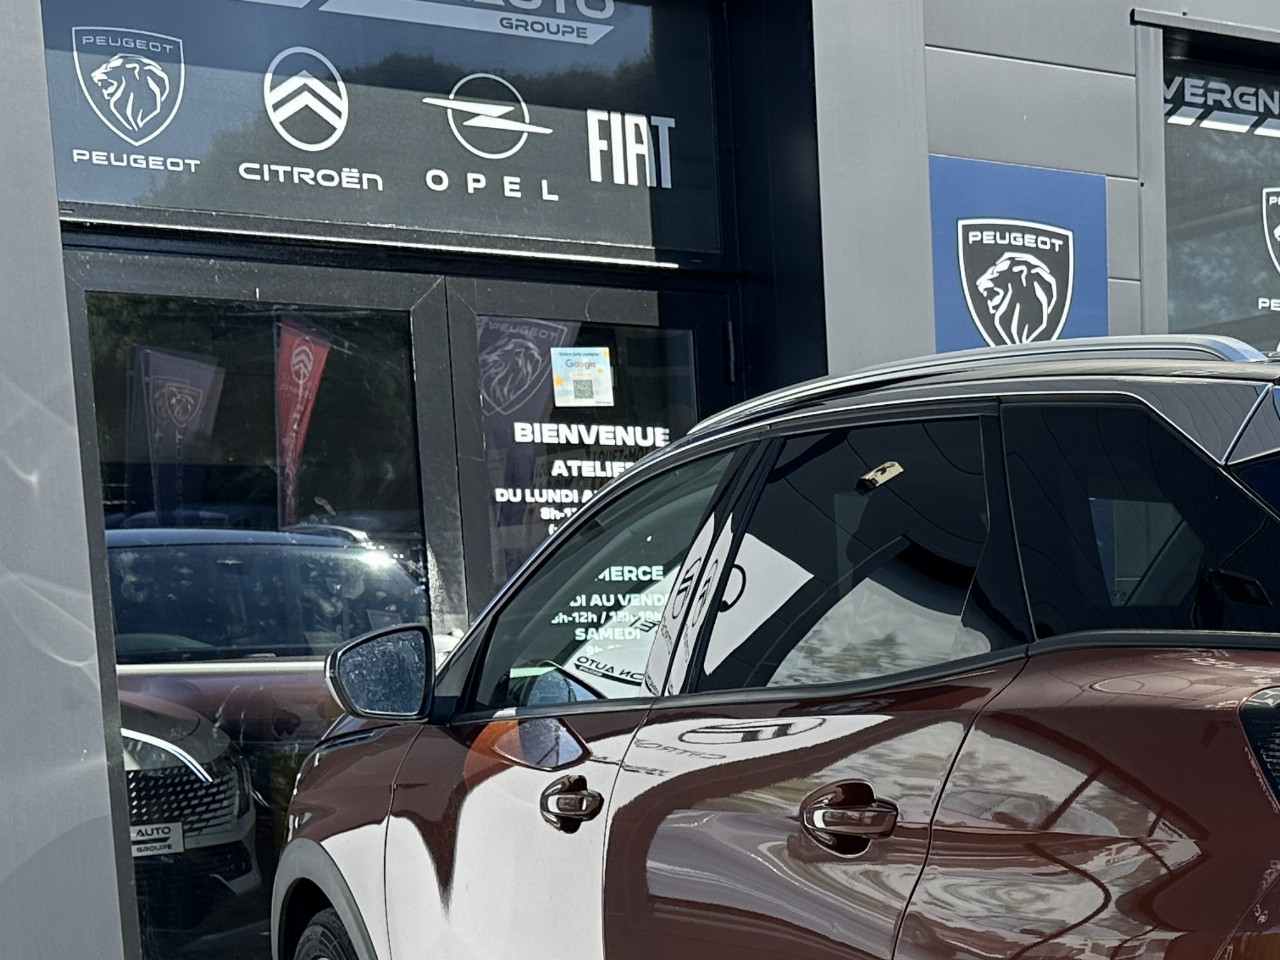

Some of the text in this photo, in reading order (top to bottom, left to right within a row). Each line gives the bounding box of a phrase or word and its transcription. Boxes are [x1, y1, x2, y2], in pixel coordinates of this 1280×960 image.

[499, 16, 588, 39] GROUPE
[82, 35, 174, 54] PEUGEOT
[586, 108, 675, 189] FIAT
[72, 148, 200, 173] PEUGEOT
[238, 162, 384, 192] CITROËN
[425, 169, 559, 202] OPEL
[969, 230, 1064, 252] PEUGEOT
[565, 359, 596, 370] Google
[513, 421, 671, 448] BIENVENUE
[494, 487, 598, 504] DU LUNDI A
[595, 565, 664, 582] MERCE
[589, 593, 615, 607] AU
[574, 627, 641, 641] SAMEDI
[136, 826, 171, 838] AUTO
[136, 844, 173, 853] GROUPE
